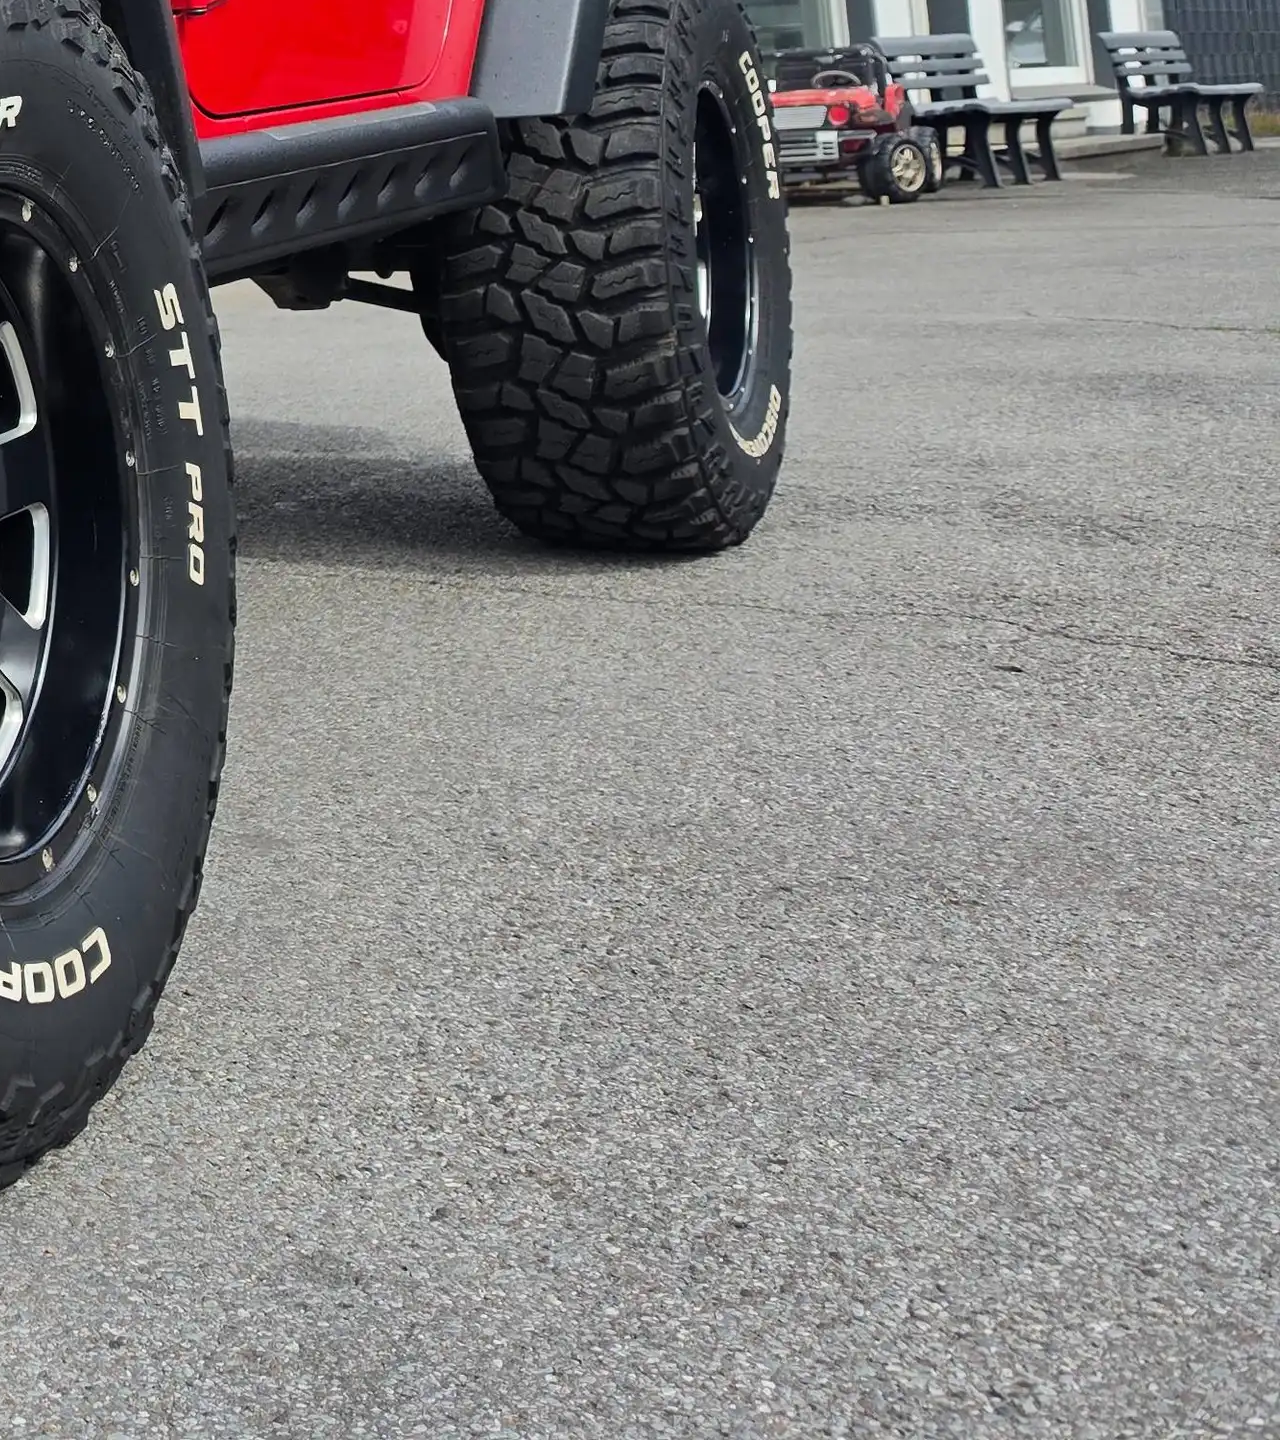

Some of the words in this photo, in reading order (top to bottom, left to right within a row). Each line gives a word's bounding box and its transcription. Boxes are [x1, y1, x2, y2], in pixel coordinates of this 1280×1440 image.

[738, 50, 781, 200] COOPER
[153, 282, 204, 437] STT
[185, 461, 205, 587] PRO
